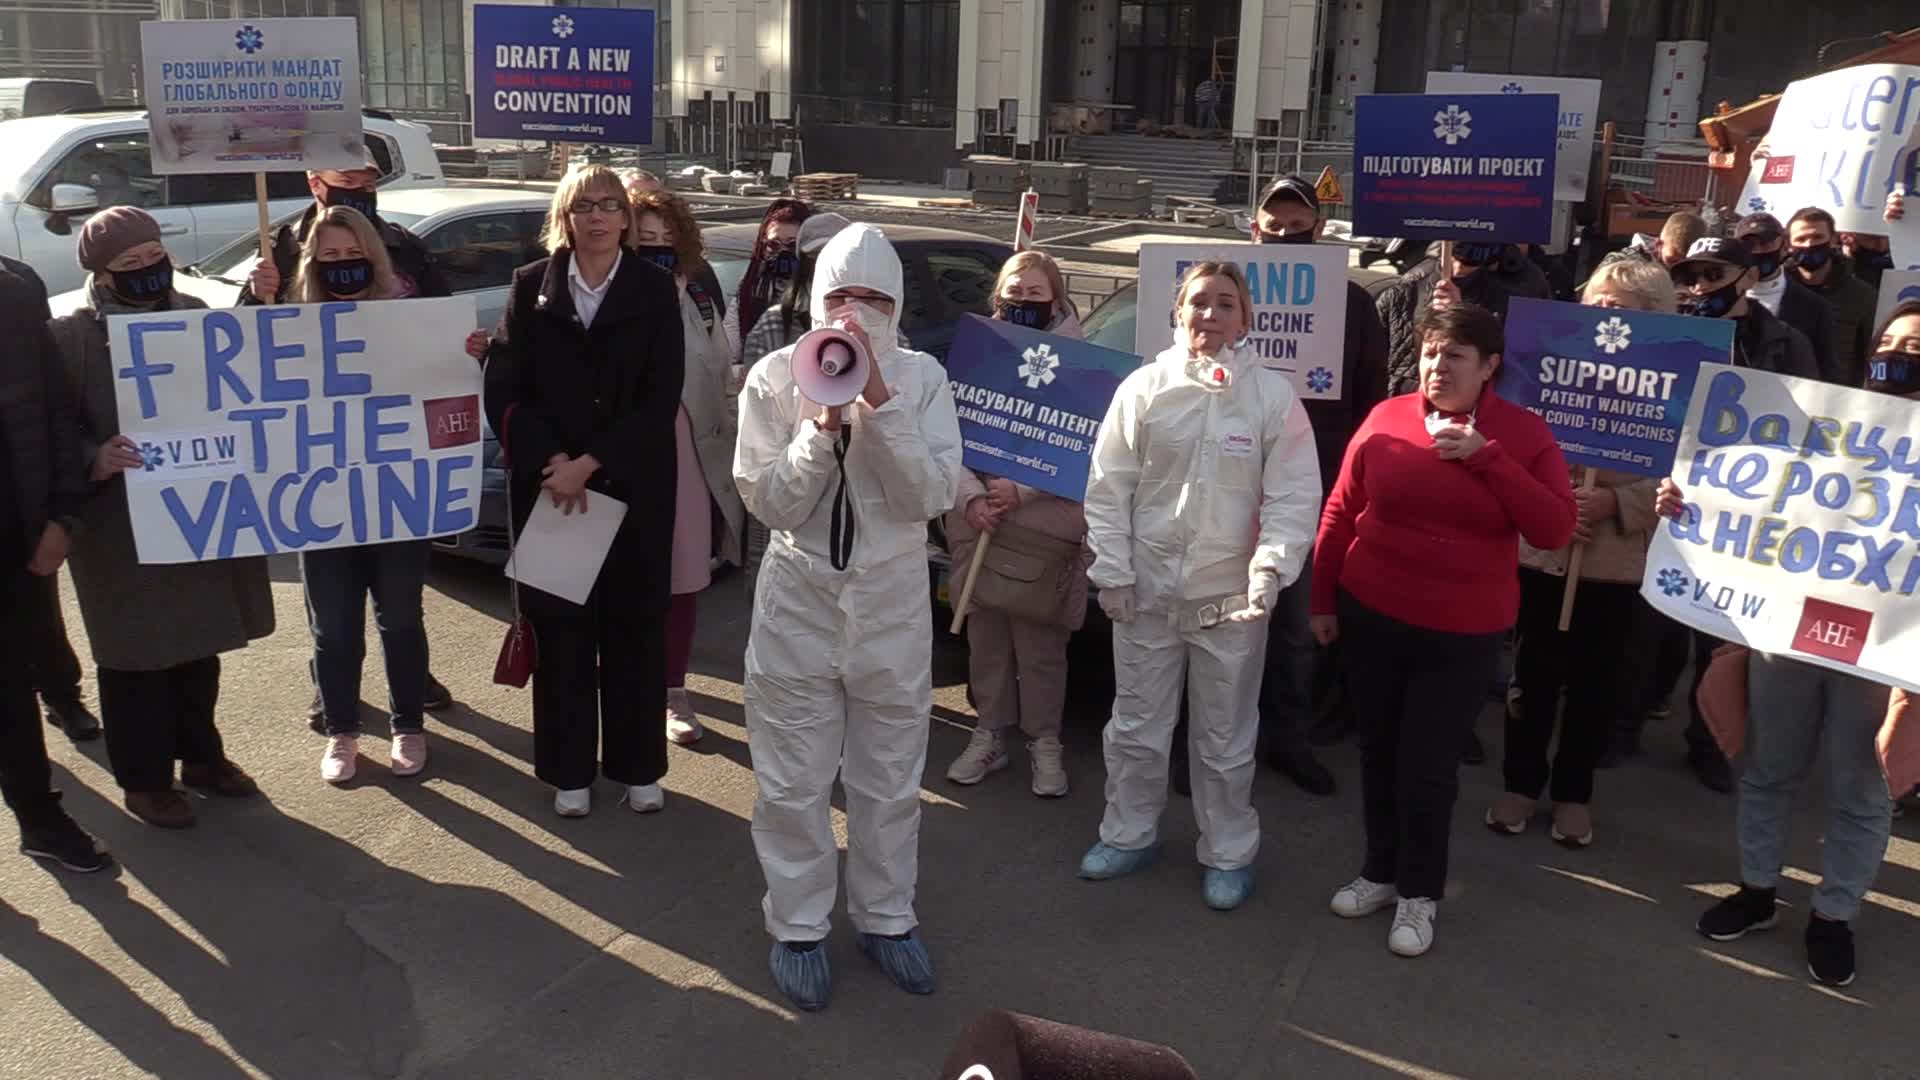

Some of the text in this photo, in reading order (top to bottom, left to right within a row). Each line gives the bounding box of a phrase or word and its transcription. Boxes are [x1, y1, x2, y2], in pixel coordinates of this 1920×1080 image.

[162, 59, 342, 80] РОЗШИРИТИ МАНДАТ
[496, 45, 631, 72] DRAFT A NEW
[164, 81, 343, 101] ГЛОБАЛЬНОГО ФОНДУ
[494, 90, 632, 116] CONVENTION
[1363, 156, 1545, 177] ПІДГОТУВАТИ ПРОЕКТ
[119, 302, 372, 419] FREE
[1539, 356, 1678, 401] SUPPORT
[950, 380, 1102, 438] СКАСУВАТИ ПАТЕНТ
[1540, 388, 1665, 420] PATENT WAIVERS
[228, 395, 412, 474] THE
[435, 411, 472, 434] AHF
[957, 405, 1093, 455] ВАКЦИНИ ПРОТИ COVID-1
[1545, 409, 1606, 432] COVID-19
[1610, 420, 1675, 443] VACCINES
[166, 435, 236, 464] VOW
[160, 455, 474, 560] VACCINE
[1692, 578, 1766, 619] VOW
[1805, 619, 1857, 648] AHF
